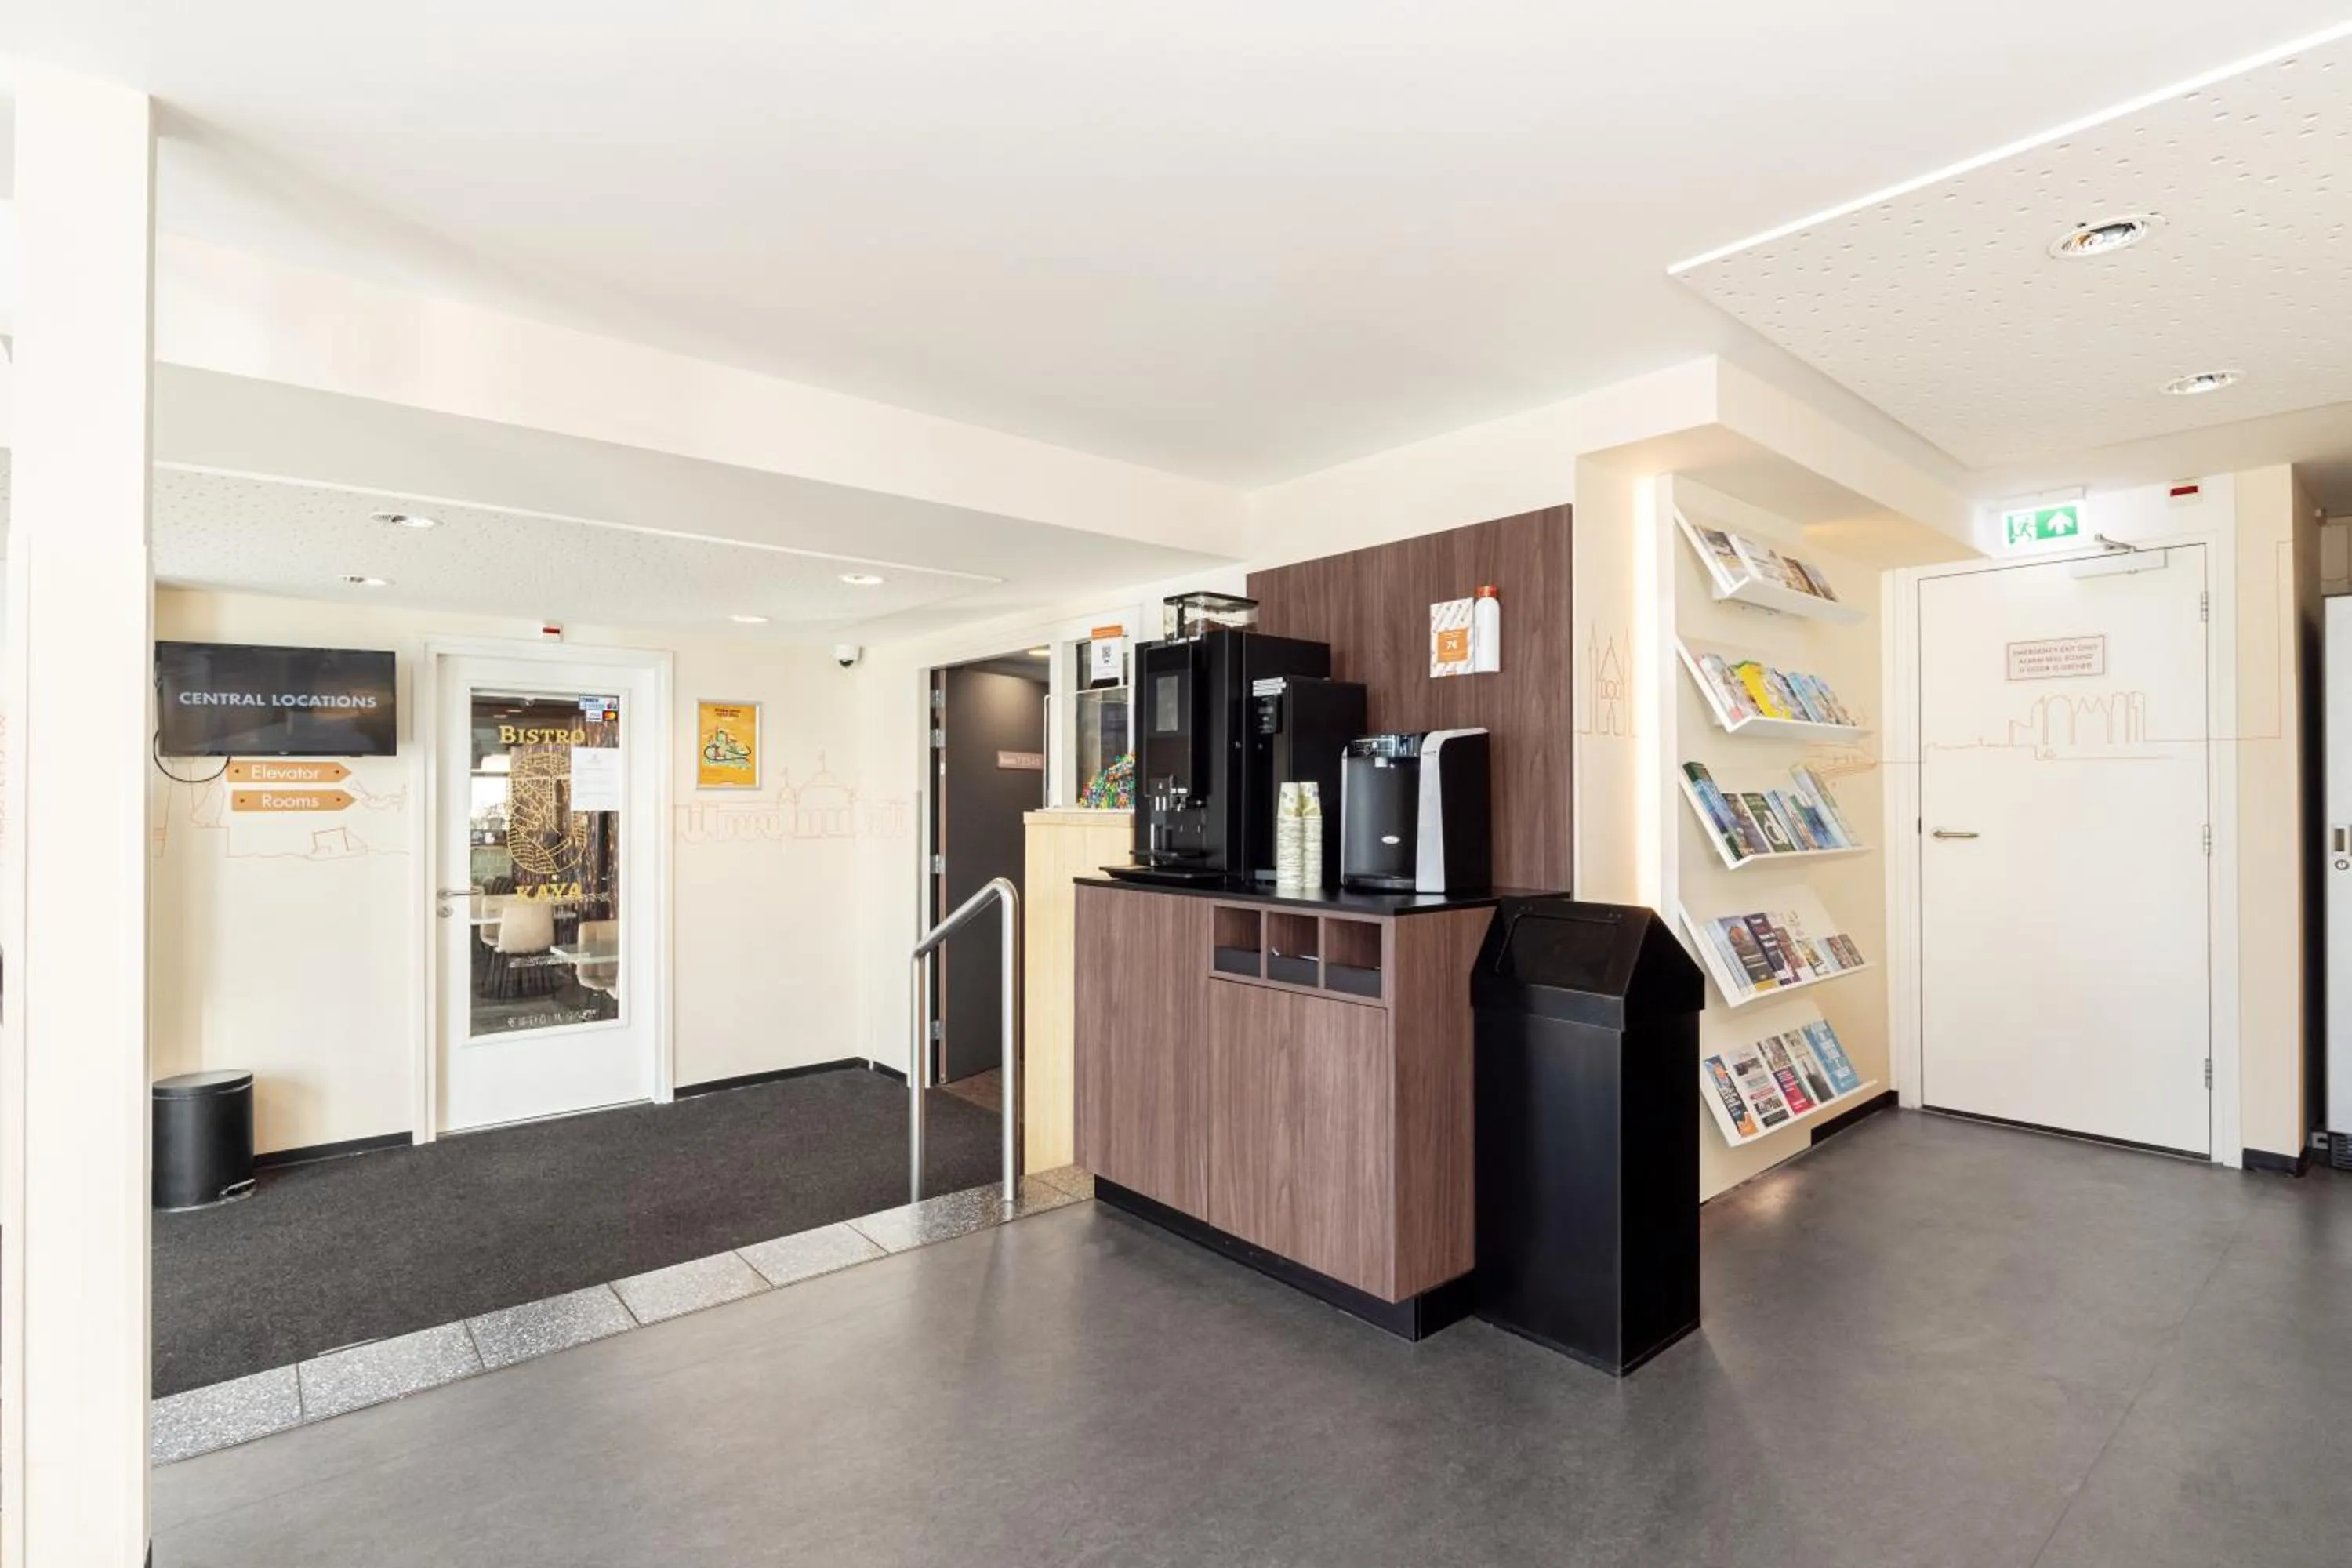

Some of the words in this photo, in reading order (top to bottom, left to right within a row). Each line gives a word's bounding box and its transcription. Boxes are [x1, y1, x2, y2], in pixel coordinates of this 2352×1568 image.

[179, 691, 266, 706] CENTRAL
[272, 694, 377, 709] LOCATIONS
[499, 724, 586, 745] BISTRO
[251, 764, 321, 780] Elevator
[262, 793, 320, 808] Rooms
[514, 882, 583, 904] KAYA
